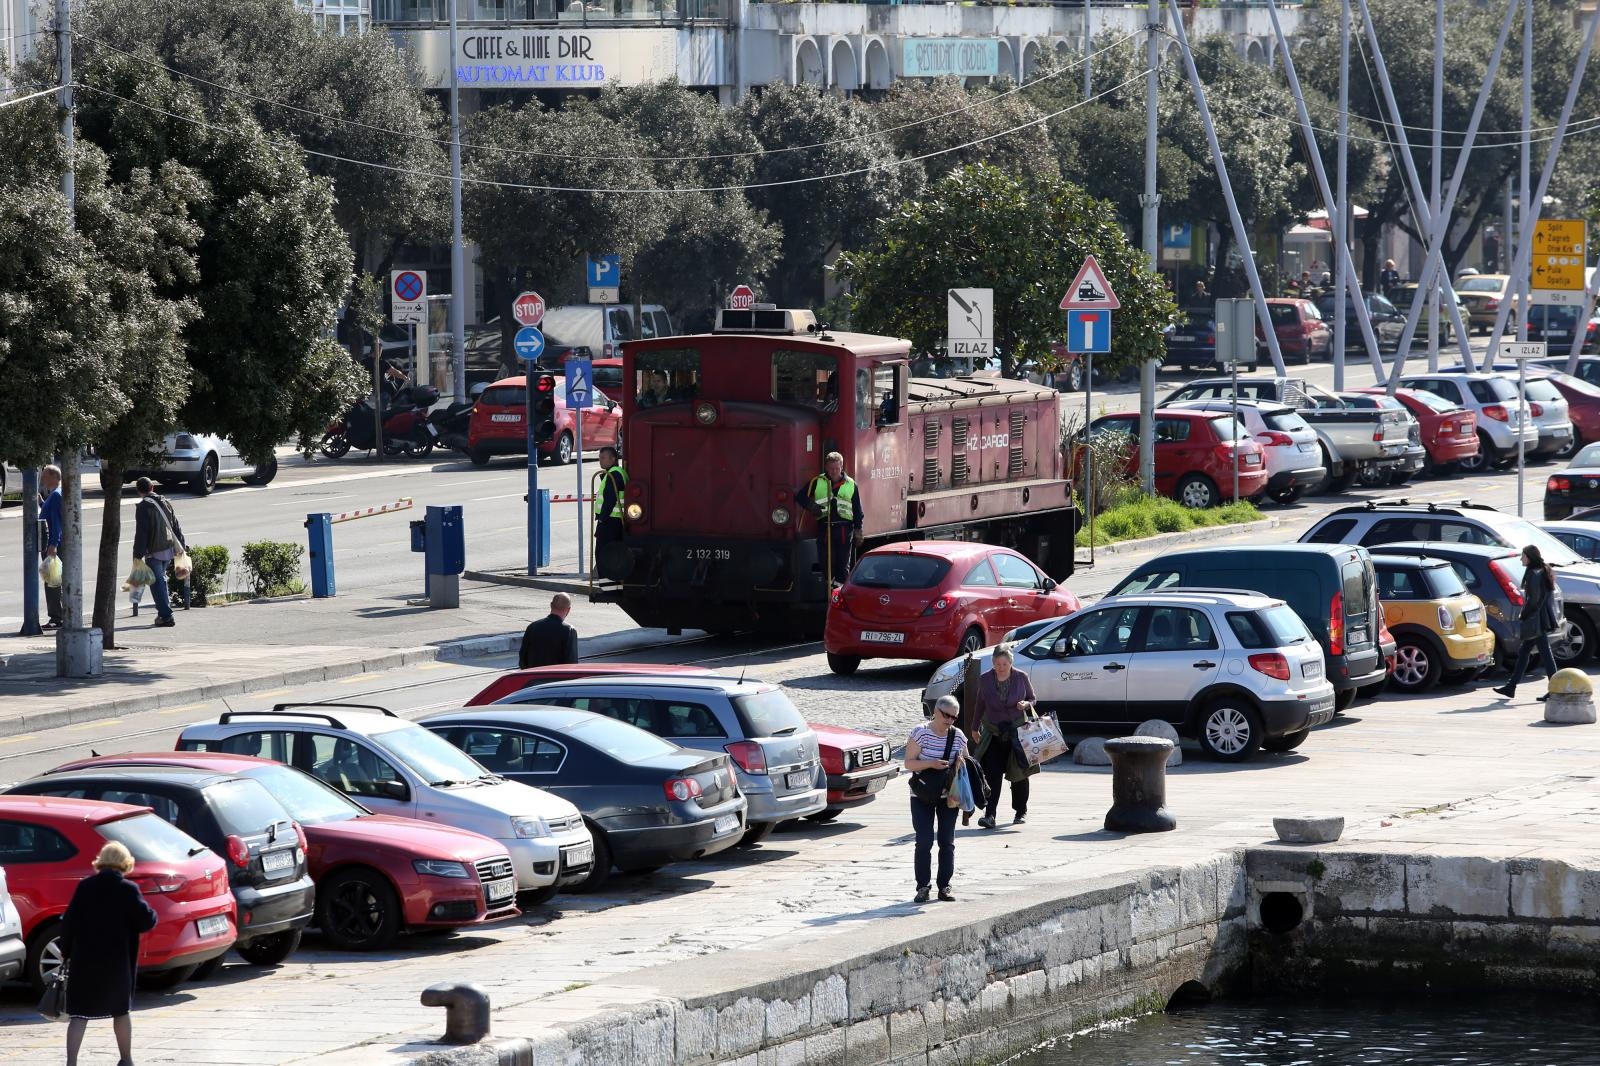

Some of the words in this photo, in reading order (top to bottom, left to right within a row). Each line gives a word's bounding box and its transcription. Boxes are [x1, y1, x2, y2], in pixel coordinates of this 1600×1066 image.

[463, 36, 502, 59] CAFFE
[505, 40, 520, 56] &
[523, 35, 550, 59] WINE
[558, 35, 594, 61] BAR
[456, 65, 550, 82] AUTOMAT
[555, 64, 605, 82] KLUB
[1548, 234, 1570, 243] Zagreb
[596, 260, 610, 281] P
[1548, 266, 1561, 274] Pula
[1547, 276, 1570, 286] Opatija
[733, 295, 753, 307] STOP
[516, 302, 542, 317] STOP
[954, 342, 988, 354] IZLAZ
[1521, 346, 1540, 354] IZLAZ
[979, 433, 1009, 450] CARGO
[696, 549, 711, 559] 132
[714, 549, 730, 560] 319
